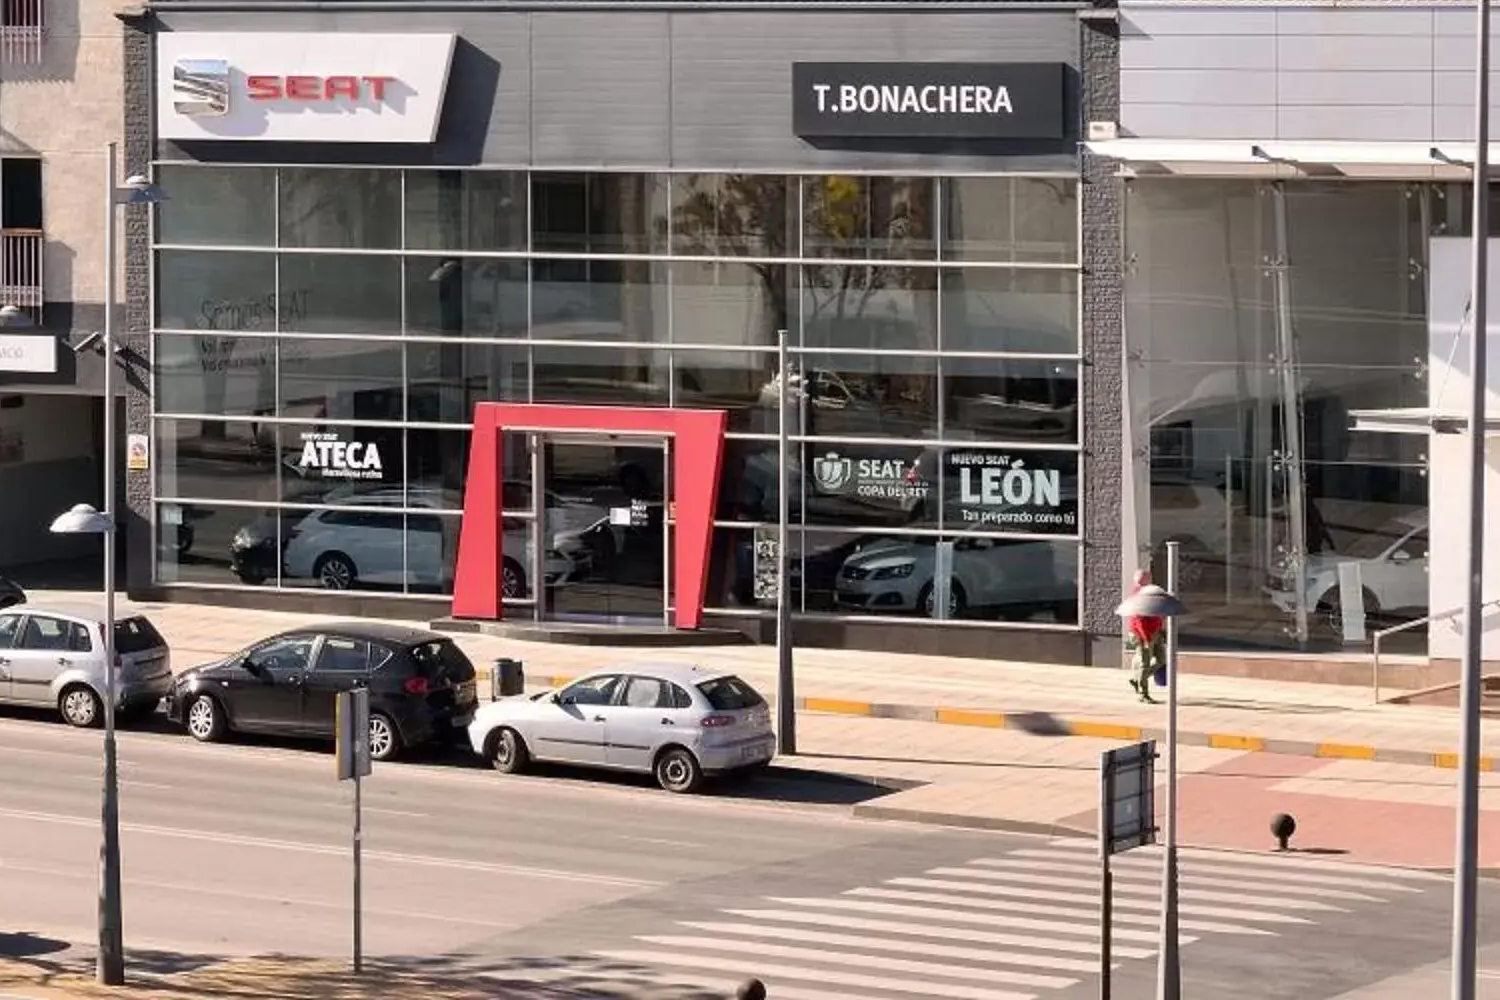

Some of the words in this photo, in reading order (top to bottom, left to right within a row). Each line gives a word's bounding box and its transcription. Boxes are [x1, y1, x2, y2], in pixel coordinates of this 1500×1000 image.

[247, 74, 397, 102] SEAT
[812, 84, 1013, 114] T.BONACHERA
[299, 440, 382, 470] ATECA
[858, 458, 905, 479] SEAT
[857, 485, 886, 497] COPA
[960, 458, 1060, 507] LEÓN
